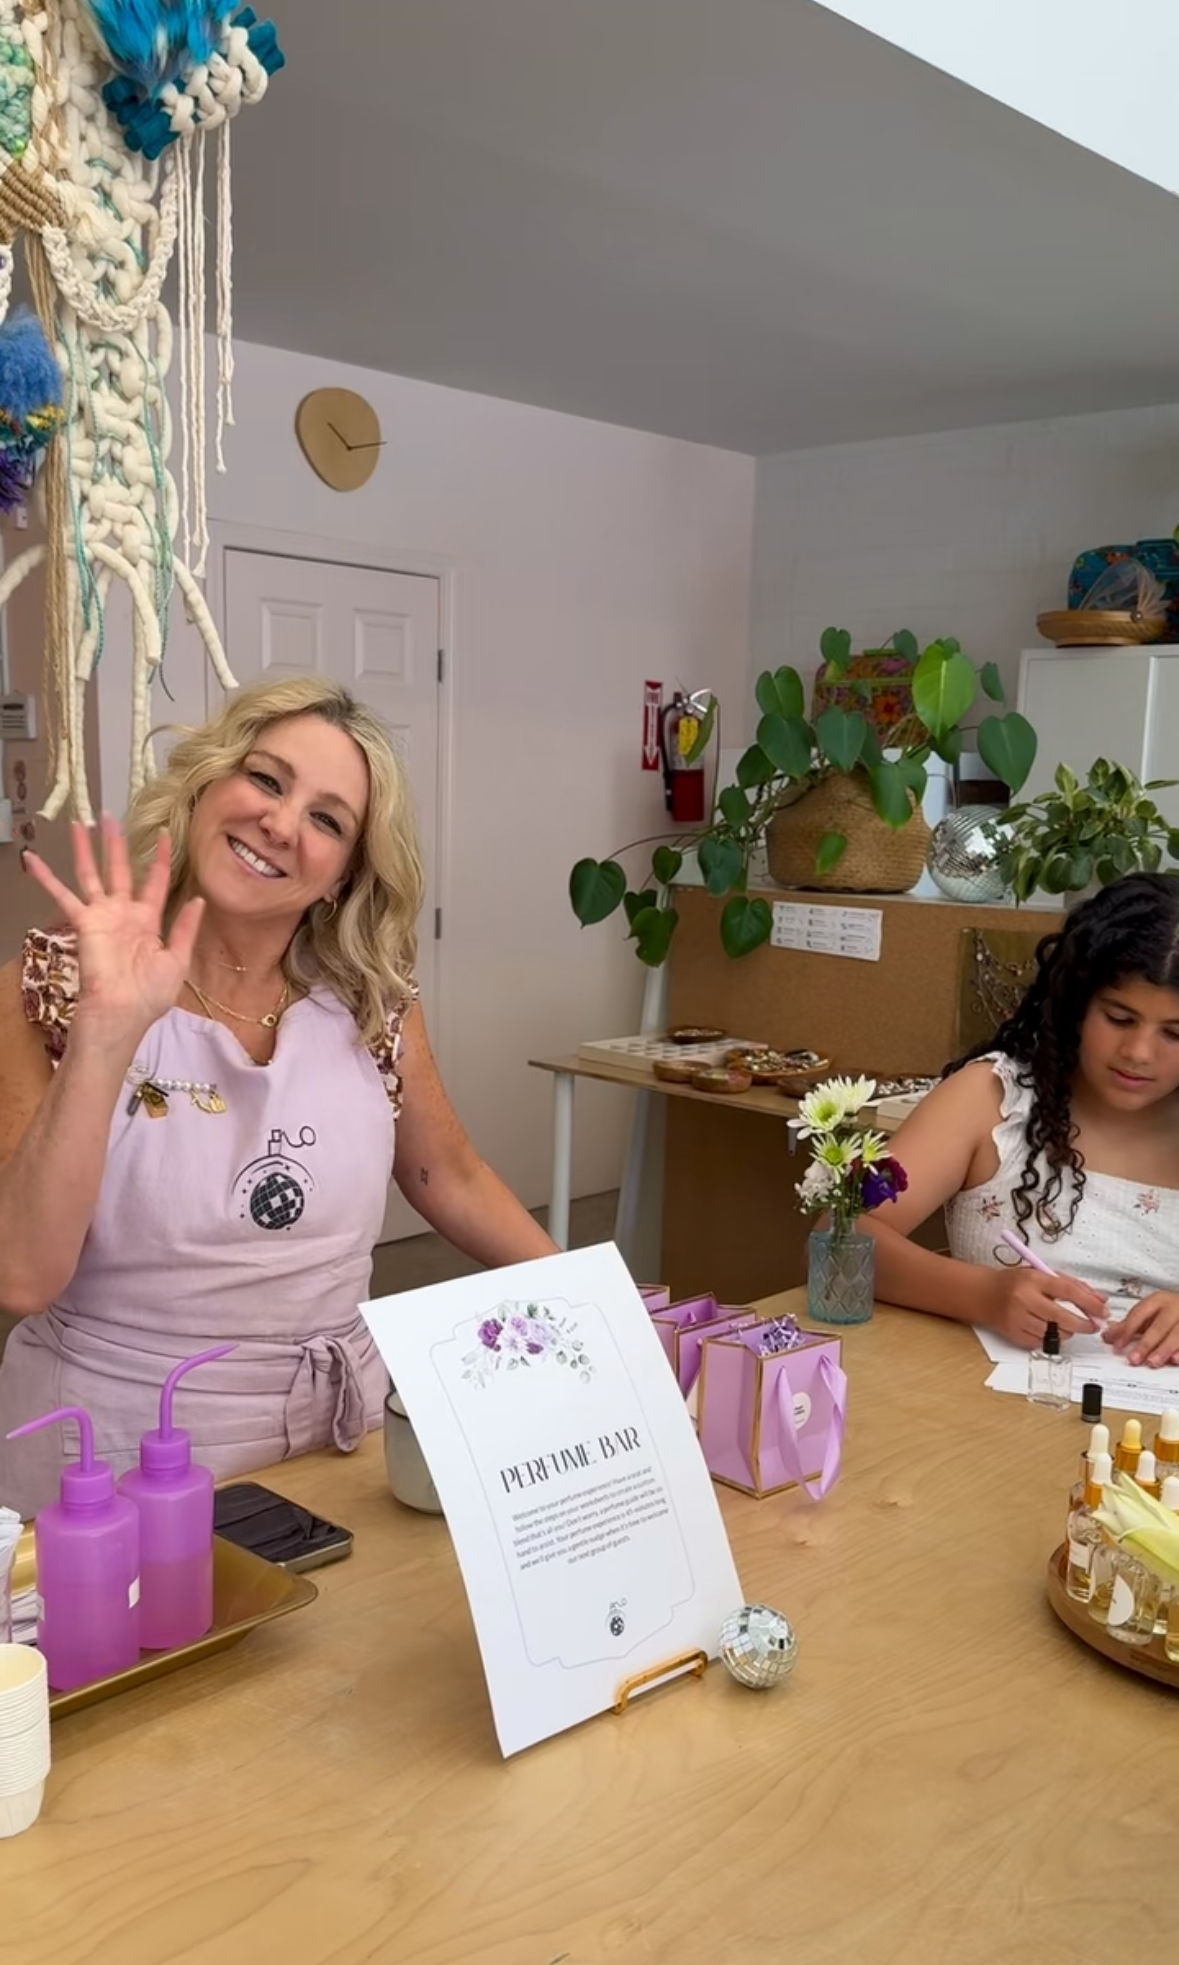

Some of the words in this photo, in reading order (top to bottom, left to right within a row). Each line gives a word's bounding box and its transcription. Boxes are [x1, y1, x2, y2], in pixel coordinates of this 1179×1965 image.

[499, 1440, 597, 1493] PERFUME
[598, 1426, 641, 1459] BAR
[558, 1492, 582, 1505] perfume
[602, 1500, 625, 1514] perfume
[569, 1525, 592, 1539] perfume
